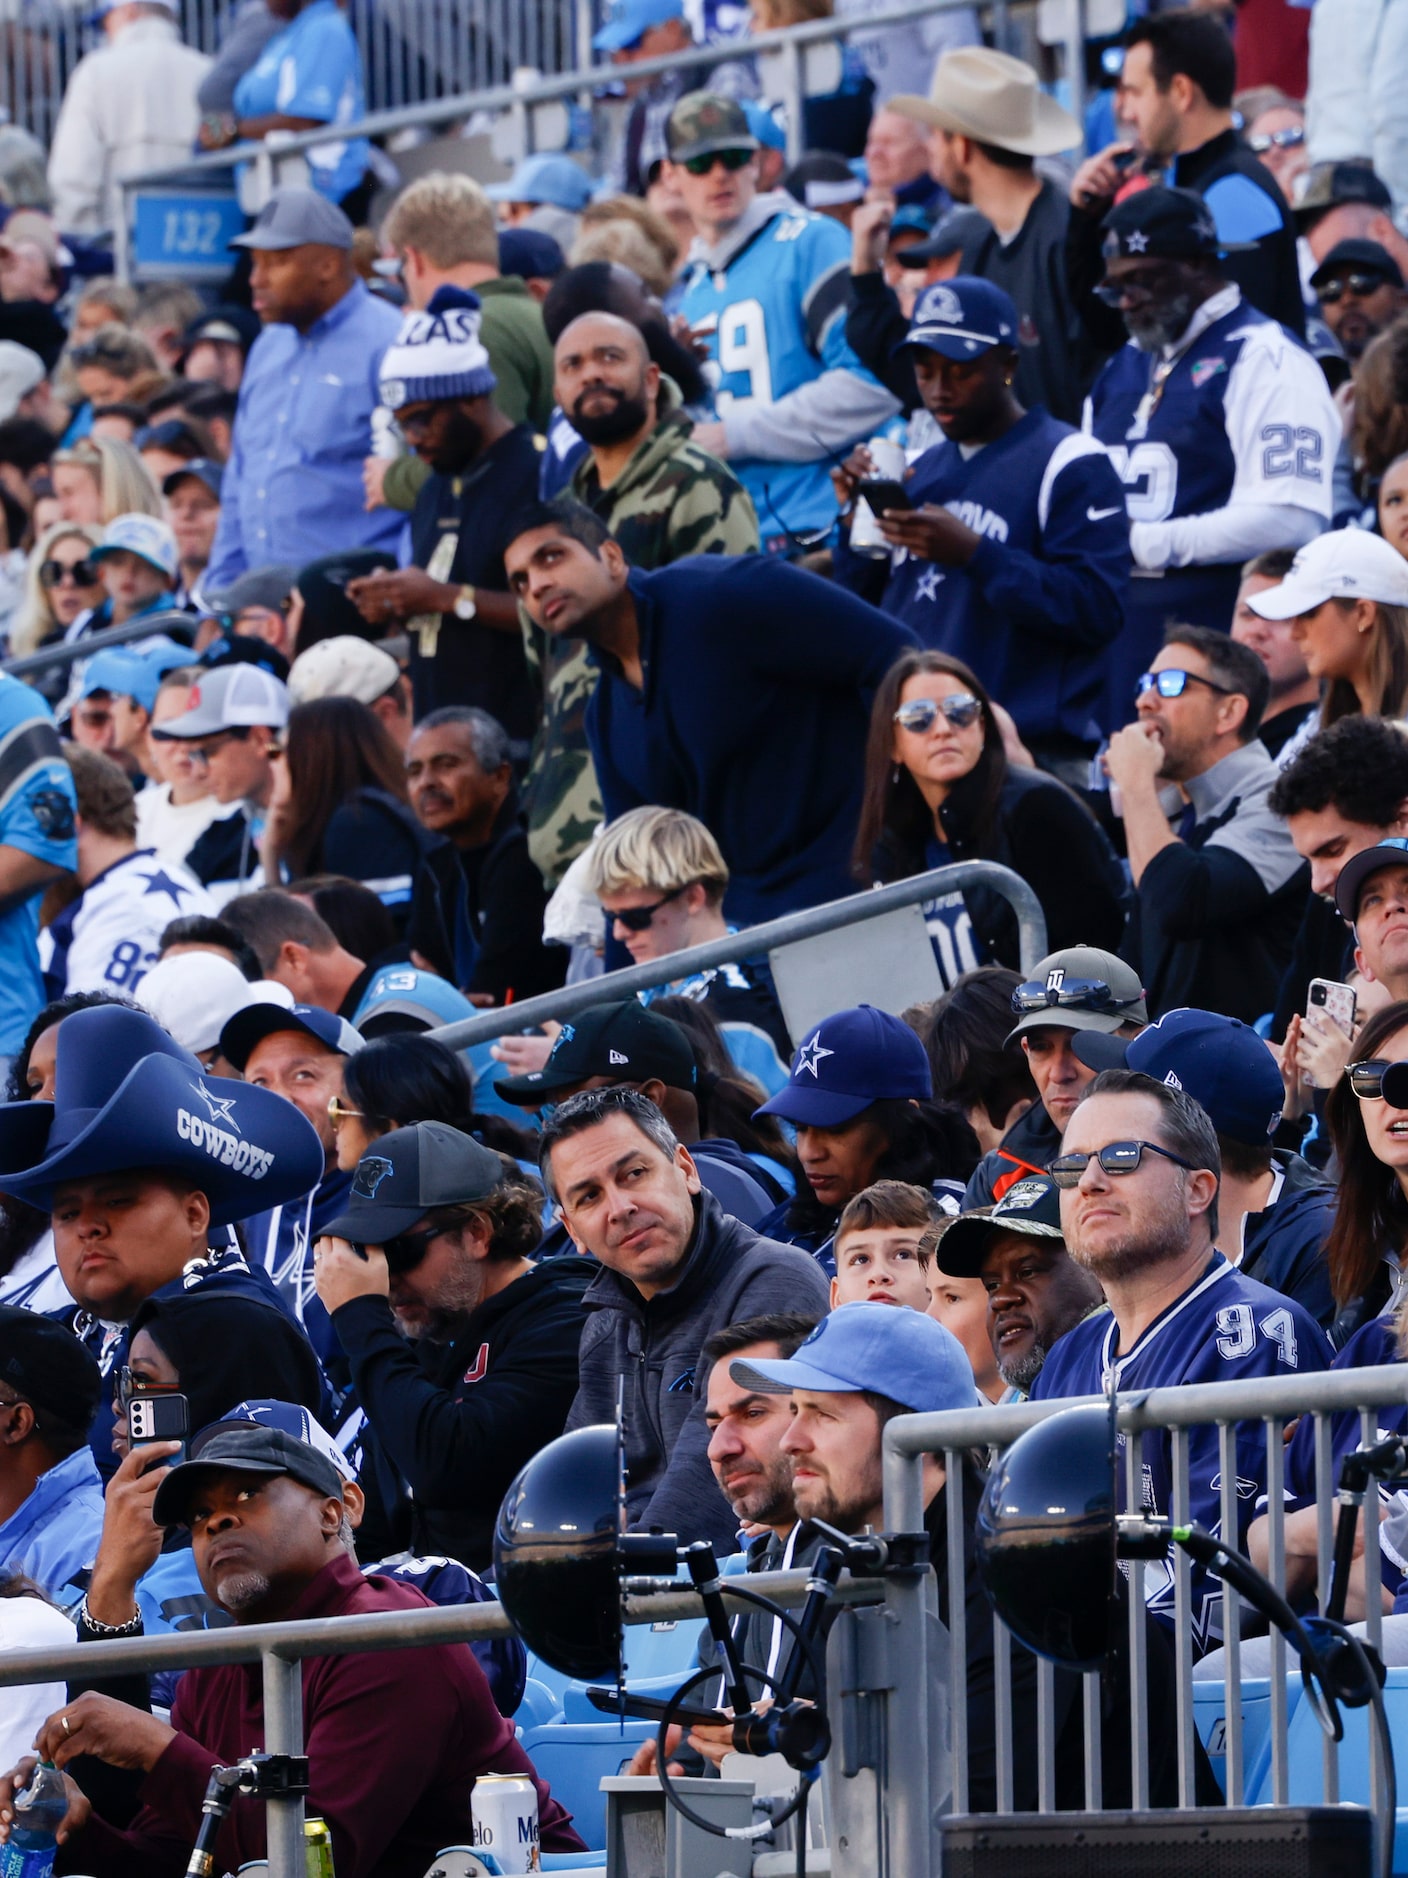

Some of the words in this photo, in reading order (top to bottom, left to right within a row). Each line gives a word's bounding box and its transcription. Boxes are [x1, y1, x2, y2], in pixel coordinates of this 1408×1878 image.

[161, 208, 222, 254] 132
[1261, 424, 1323, 484] 22
[177, 1108, 276, 1181] COWBOYS
[1215, 1303, 1298, 1369] 94
[1217, 1726, 1226, 1751] 1
